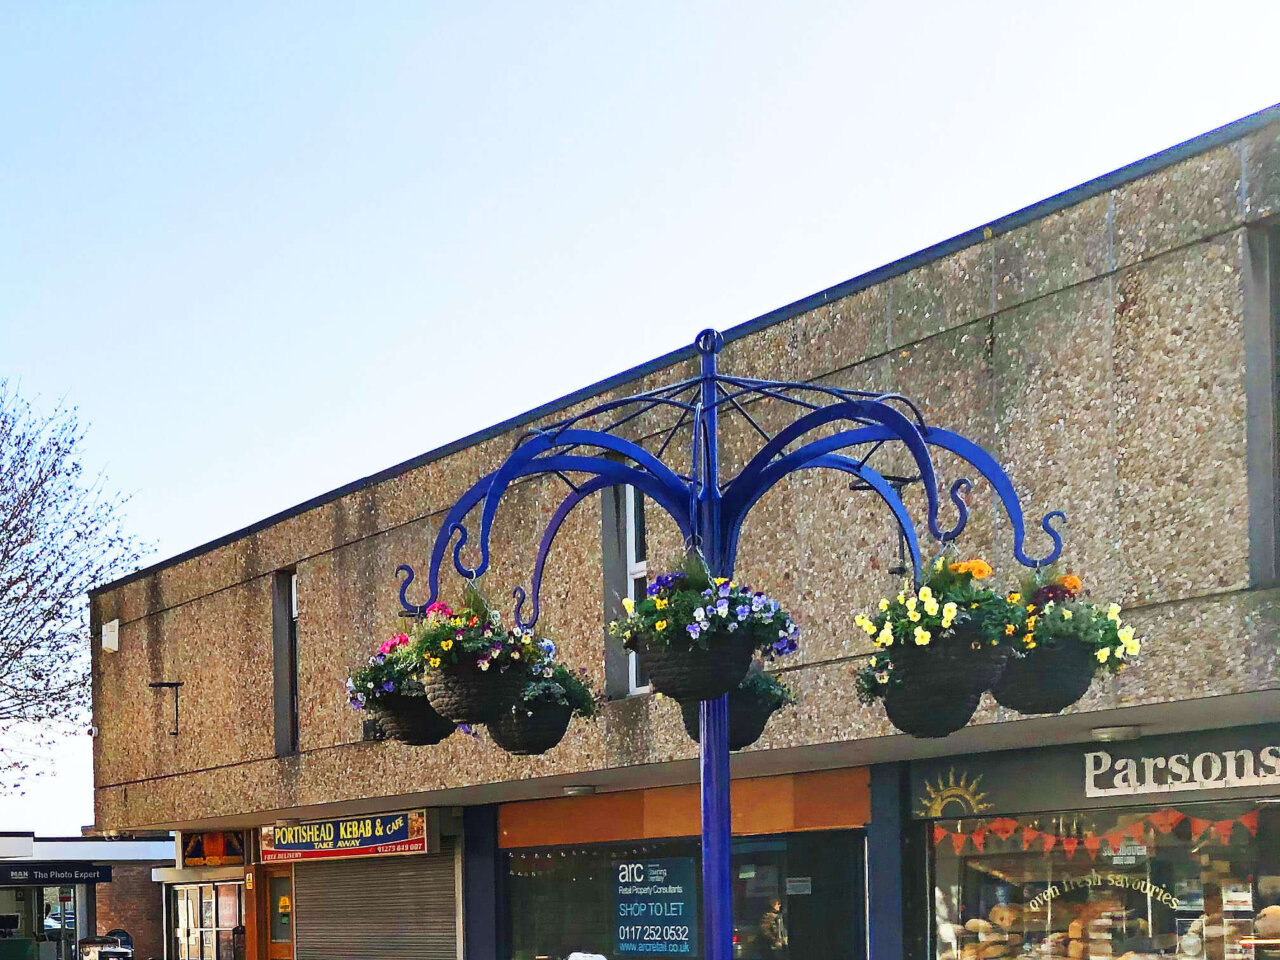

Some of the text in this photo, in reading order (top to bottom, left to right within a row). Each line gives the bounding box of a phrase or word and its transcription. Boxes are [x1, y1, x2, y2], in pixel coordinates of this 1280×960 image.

[1083, 745, 1280, 793] Parsons
[275, 816, 405, 845] PORTISHEAD KEBAB & CAFE
[313, 838, 361, 849] TAKE AWAY
[33, 871, 48, 879] The
[49, 871, 73, 879] Photo
[74, 871, 100, 880] Expert
[618, 863, 644, 882] arc
[618, 885, 683, 895] Retail Property Consultants
[1029, 868, 1181, 912] oven fresh savouries
[619, 902, 685, 916] SHOP TO LET
[619, 926, 689, 941] 0117 252 0532
